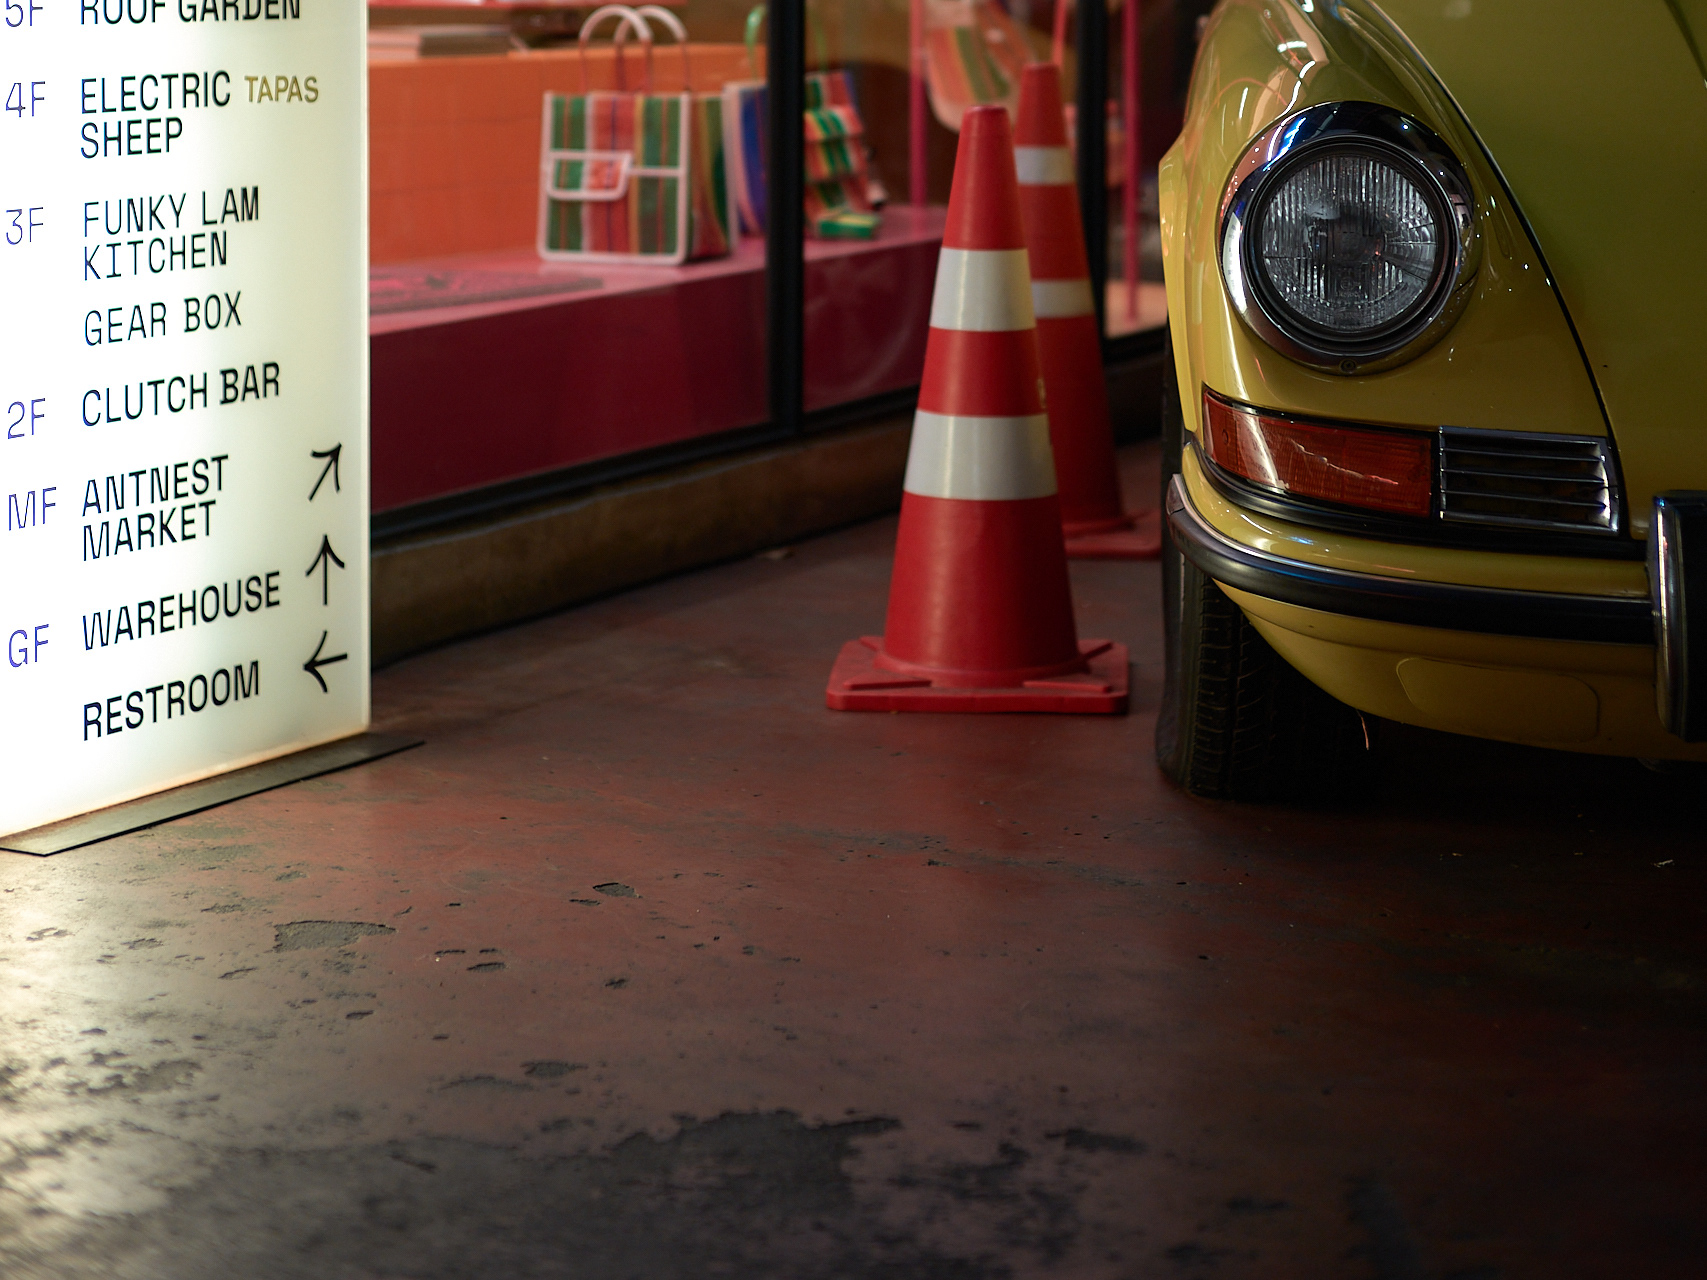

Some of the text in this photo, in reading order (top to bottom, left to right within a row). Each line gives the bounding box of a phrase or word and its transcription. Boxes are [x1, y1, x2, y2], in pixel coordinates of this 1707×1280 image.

[6, 70, 318, 117] 4F ELECTRIC TAPAS
[81, 117, 182, 159] SHEEP
[6, 186, 258, 245] 3F FUNKY LAM
[84, 231, 226, 281] KITCHEN
[85, 291, 241, 346] GEAR BOX
[8, 362, 279, 439] 2F CLUTCH BAR
[9, 454, 228, 531] MF ANTNEST
[82, 500, 216, 561] MARKET
[9, 571, 280, 667] GF WAREHOUSE
[84, 660, 258, 741] RESTROOM
